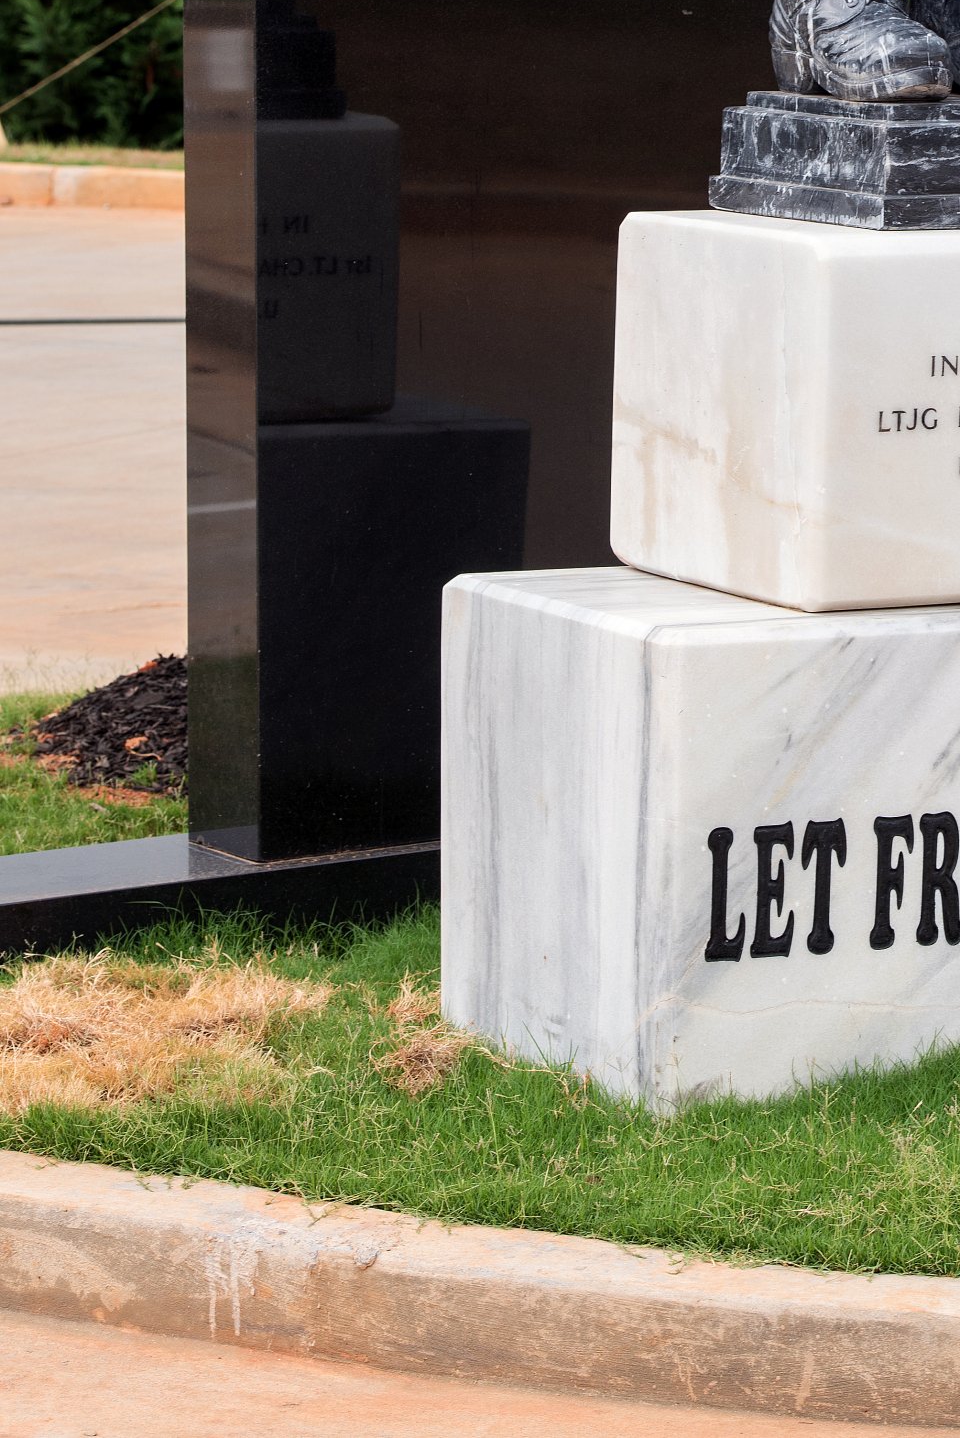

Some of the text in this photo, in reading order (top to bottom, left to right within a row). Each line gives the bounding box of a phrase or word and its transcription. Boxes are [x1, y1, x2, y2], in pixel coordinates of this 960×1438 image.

[931, 355, 959, 377] IN
[878, 408, 938, 432] LTJG
[705, 817, 847, 962] LET
